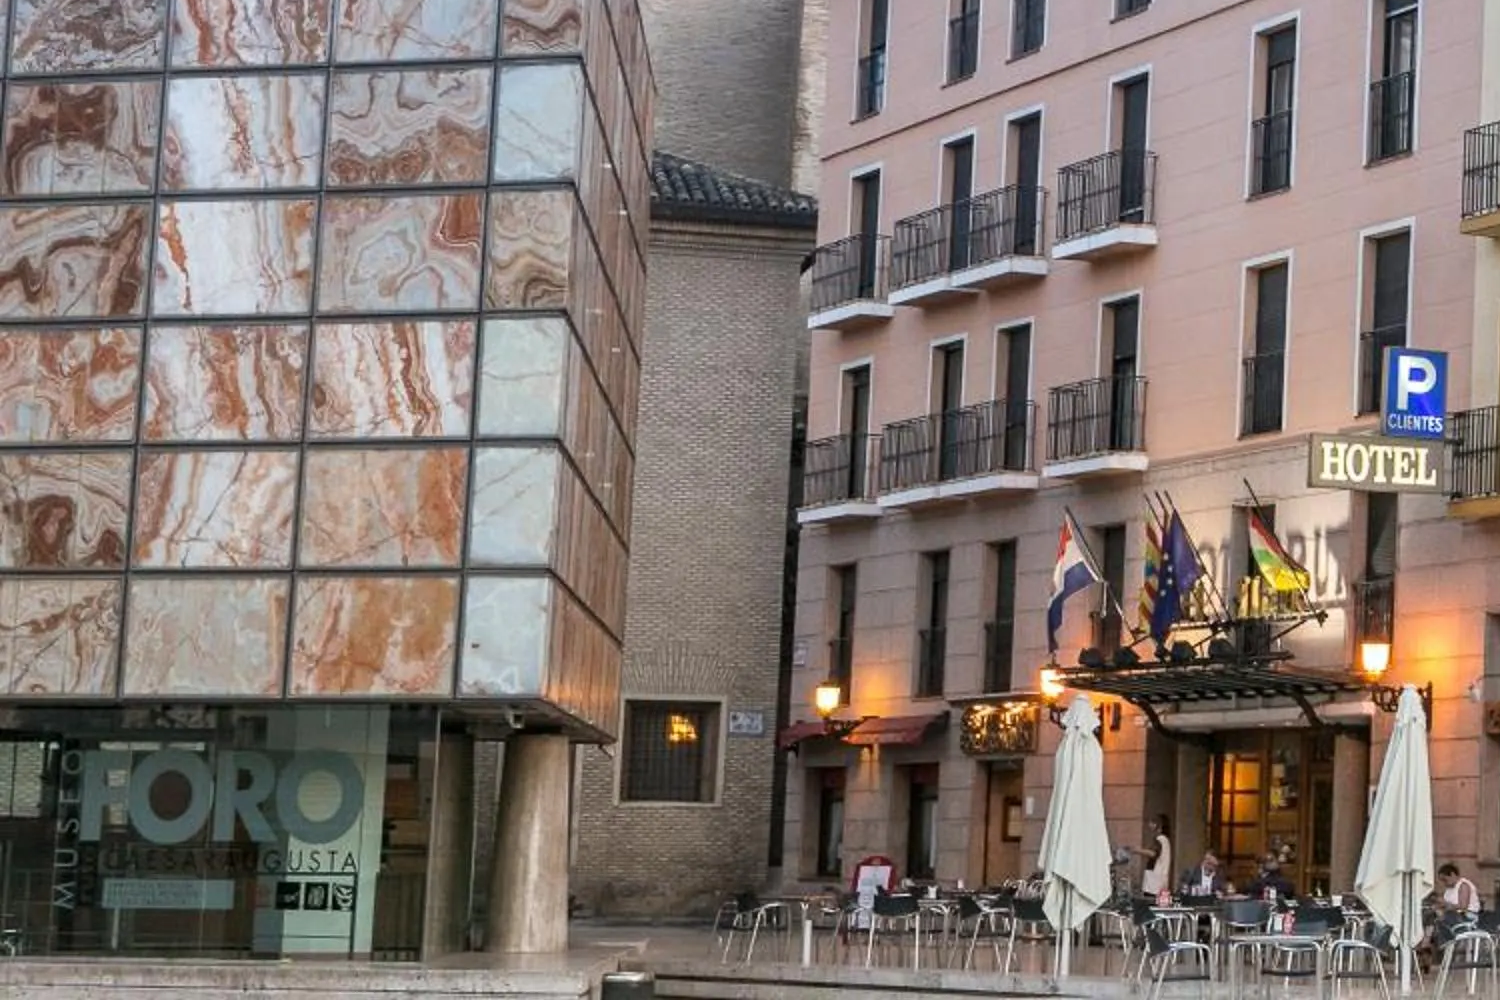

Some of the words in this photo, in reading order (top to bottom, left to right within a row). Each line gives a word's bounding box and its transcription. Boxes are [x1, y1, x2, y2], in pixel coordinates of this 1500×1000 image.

[1397, 355, 1437, 411] P
[1388, 413, 1443, 433] CLIENTES
[1320, 441, 1437, 486] HOTEL
[79, 749, 365, 844] FORO
[52, 750, 83, 910] MUSEO
[104, 849, 358, 872] CAESARAUGUSTA
